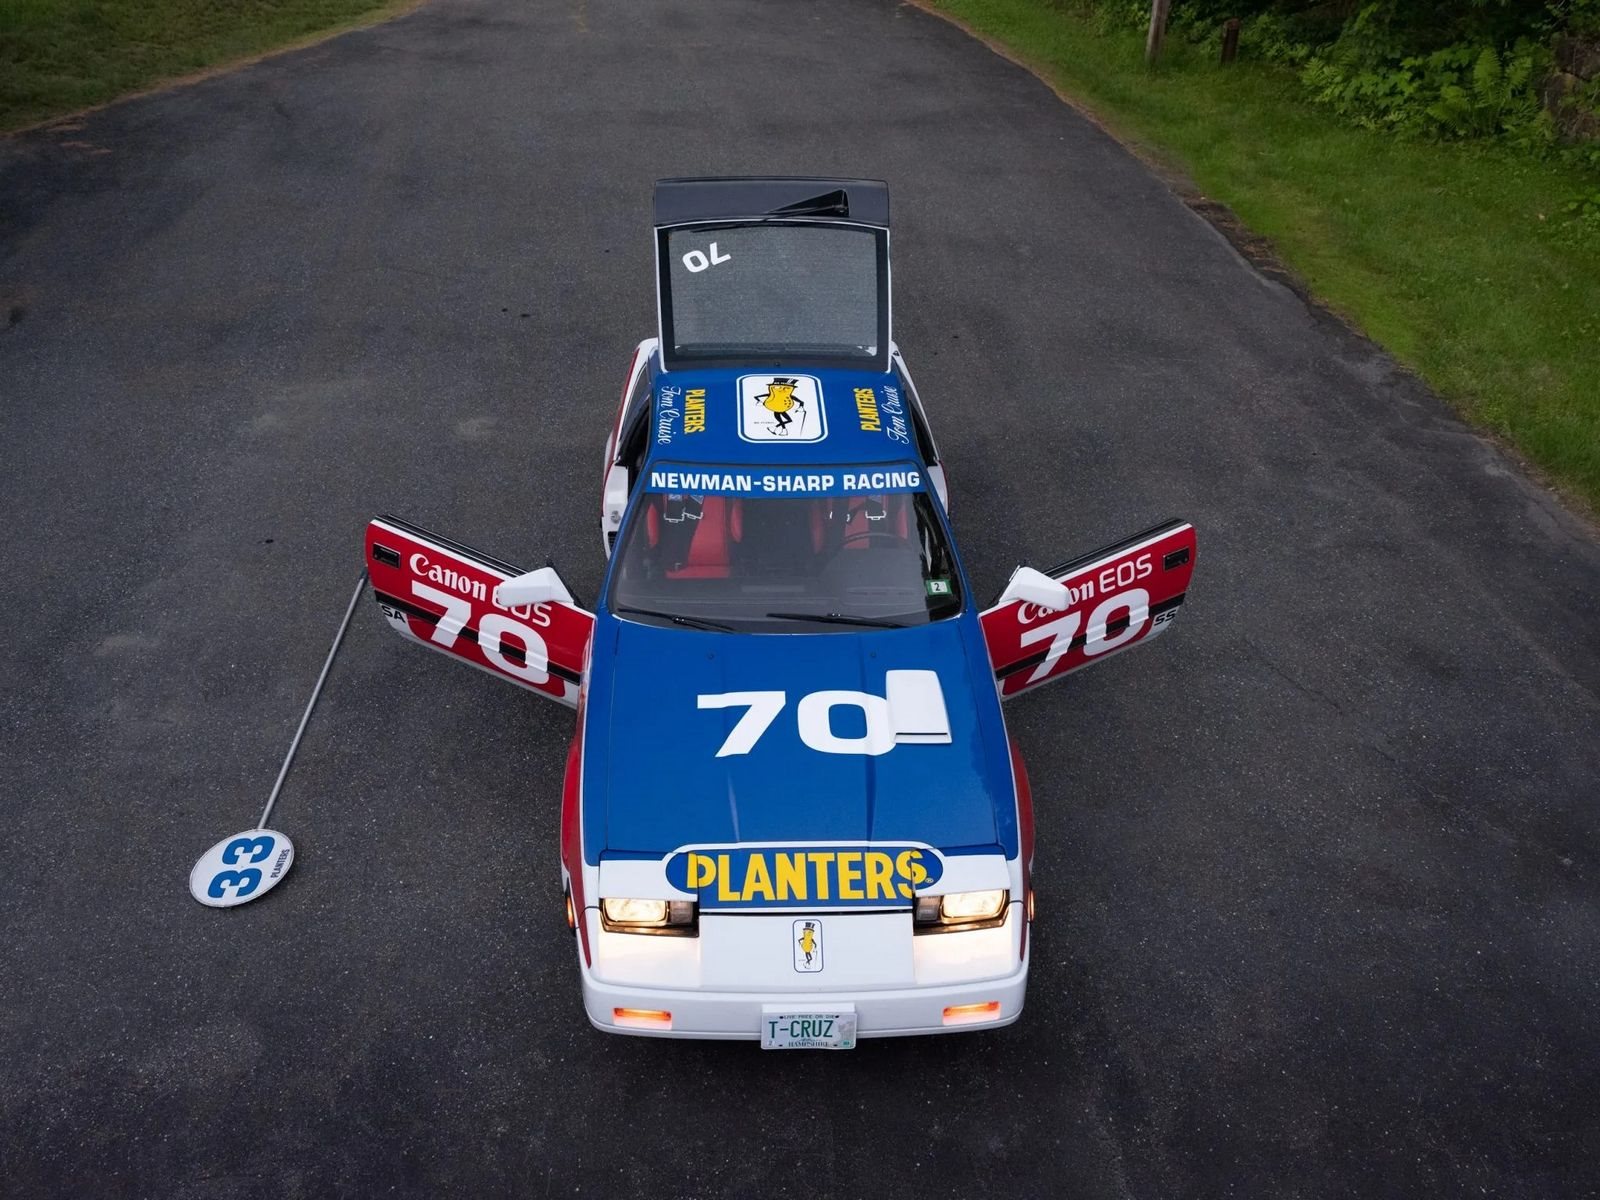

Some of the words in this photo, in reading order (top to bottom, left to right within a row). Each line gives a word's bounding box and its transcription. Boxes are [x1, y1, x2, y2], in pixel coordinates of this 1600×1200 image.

[660, 386, 681, 408] Tom
[684, 389, 705, 434] PLANTERS
[853, 387, 882, 431] PLANTERS
[880, 385, 903, 415] Cruise
[658, 408, 680, 445] Cruise
[886, 415, 910, 445] Tom
[651, 472, 834, 492] NEWMAN-SHARP
[843, 471, 920, 491] RACING
[409, 553, 486, 602] Canon
[933, 582, 941, 592] 2
[1017, 580, 1095, 625] Caon
[1099, 553, 1153, 593] EOS
[411, 580, 550, 685] 70
[1020, 588, 1149, 686] 70
[697, 690, 897, 758] 70
[207, 835, 276, 899] 33
[270, 848, 291, 879] PLANTERS
[686, 849, 928, 903] PLANTERS
[769, 1020, 834, 1039] T-CRUZ
